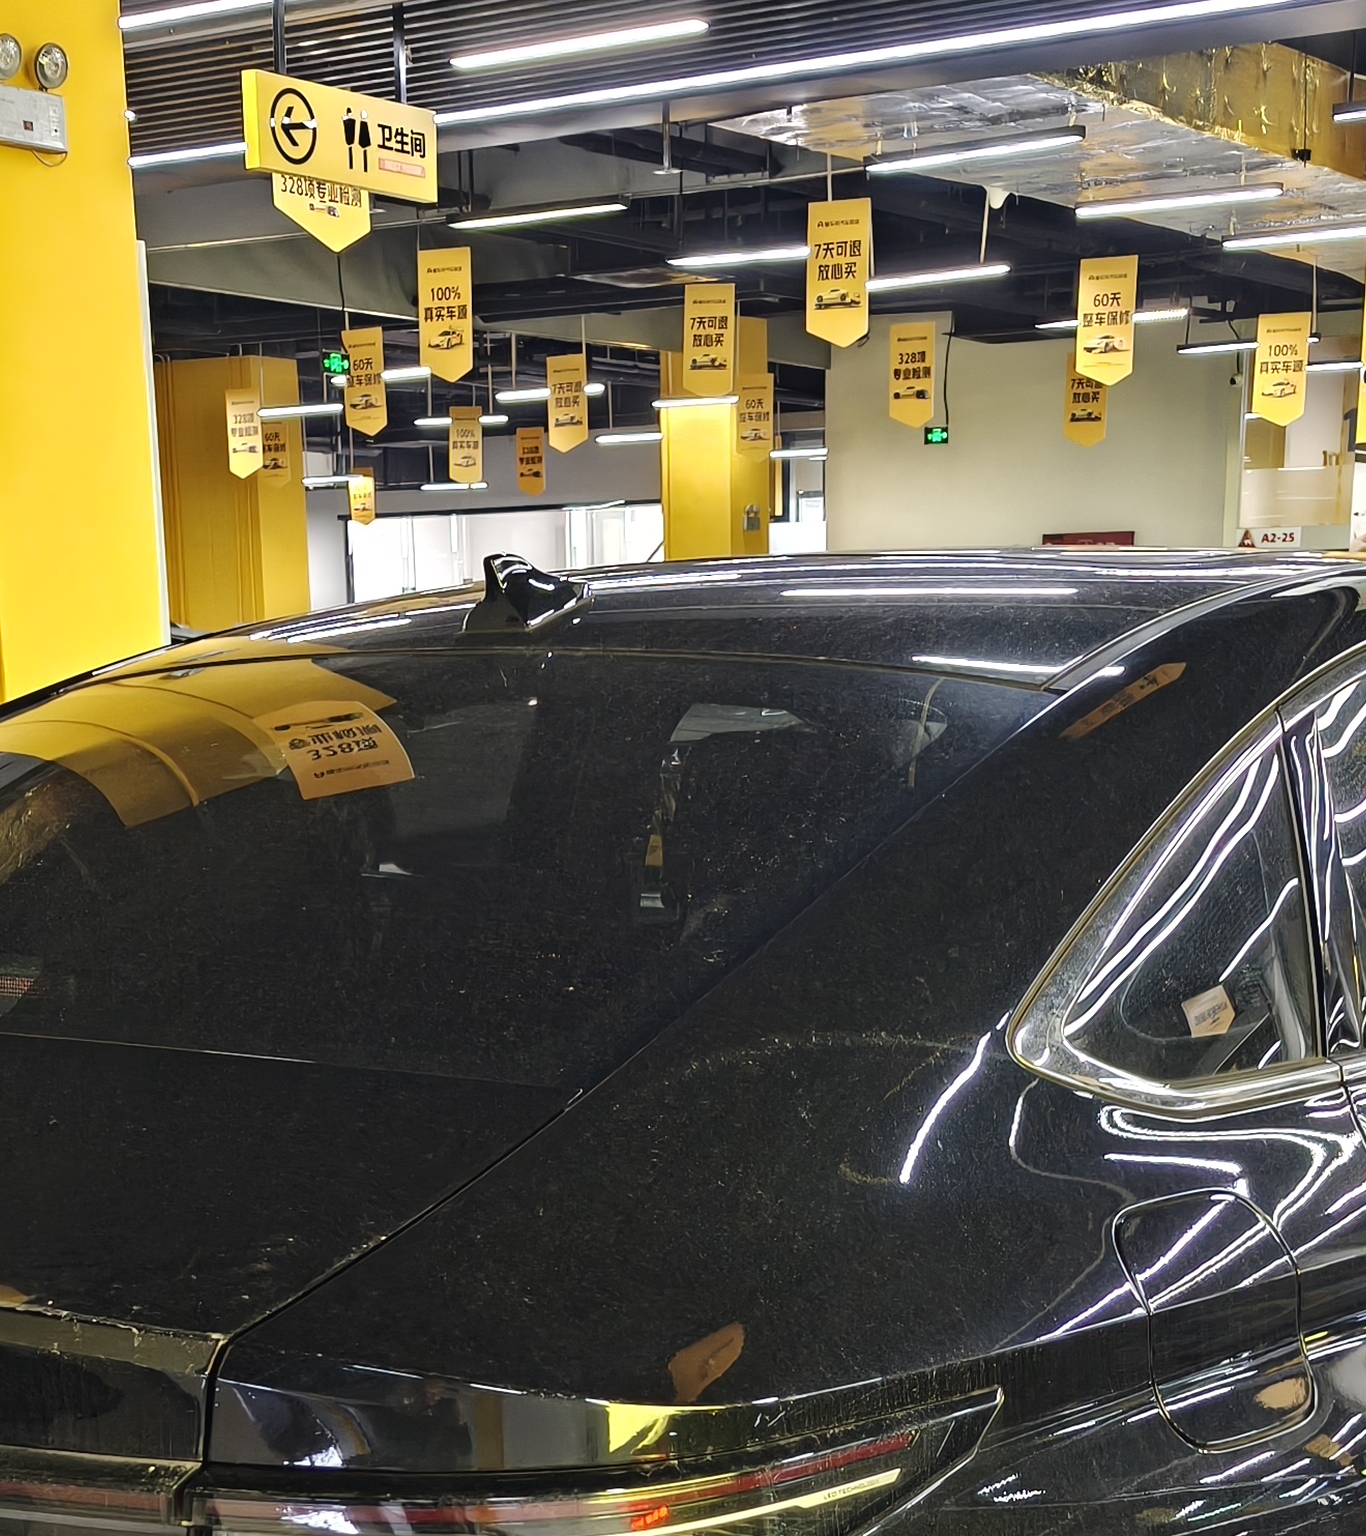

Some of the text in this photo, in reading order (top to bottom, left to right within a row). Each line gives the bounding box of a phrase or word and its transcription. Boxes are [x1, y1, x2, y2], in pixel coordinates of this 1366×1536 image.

[377, 123, 426, 159] 卫生间
[814, 240, 862, 260] 7天可退
[817, 262, 857, 282] 放心买
[430, 286, 462, 301] 100%
[1093, 291, 1122, 307] 60天
[692, 333, 724, 347] 放心买
[1268, 344, 1299, 357] 100%
[352, 358, 374, 371] 60天
[1261, 532, 1295, 543] A2-25
